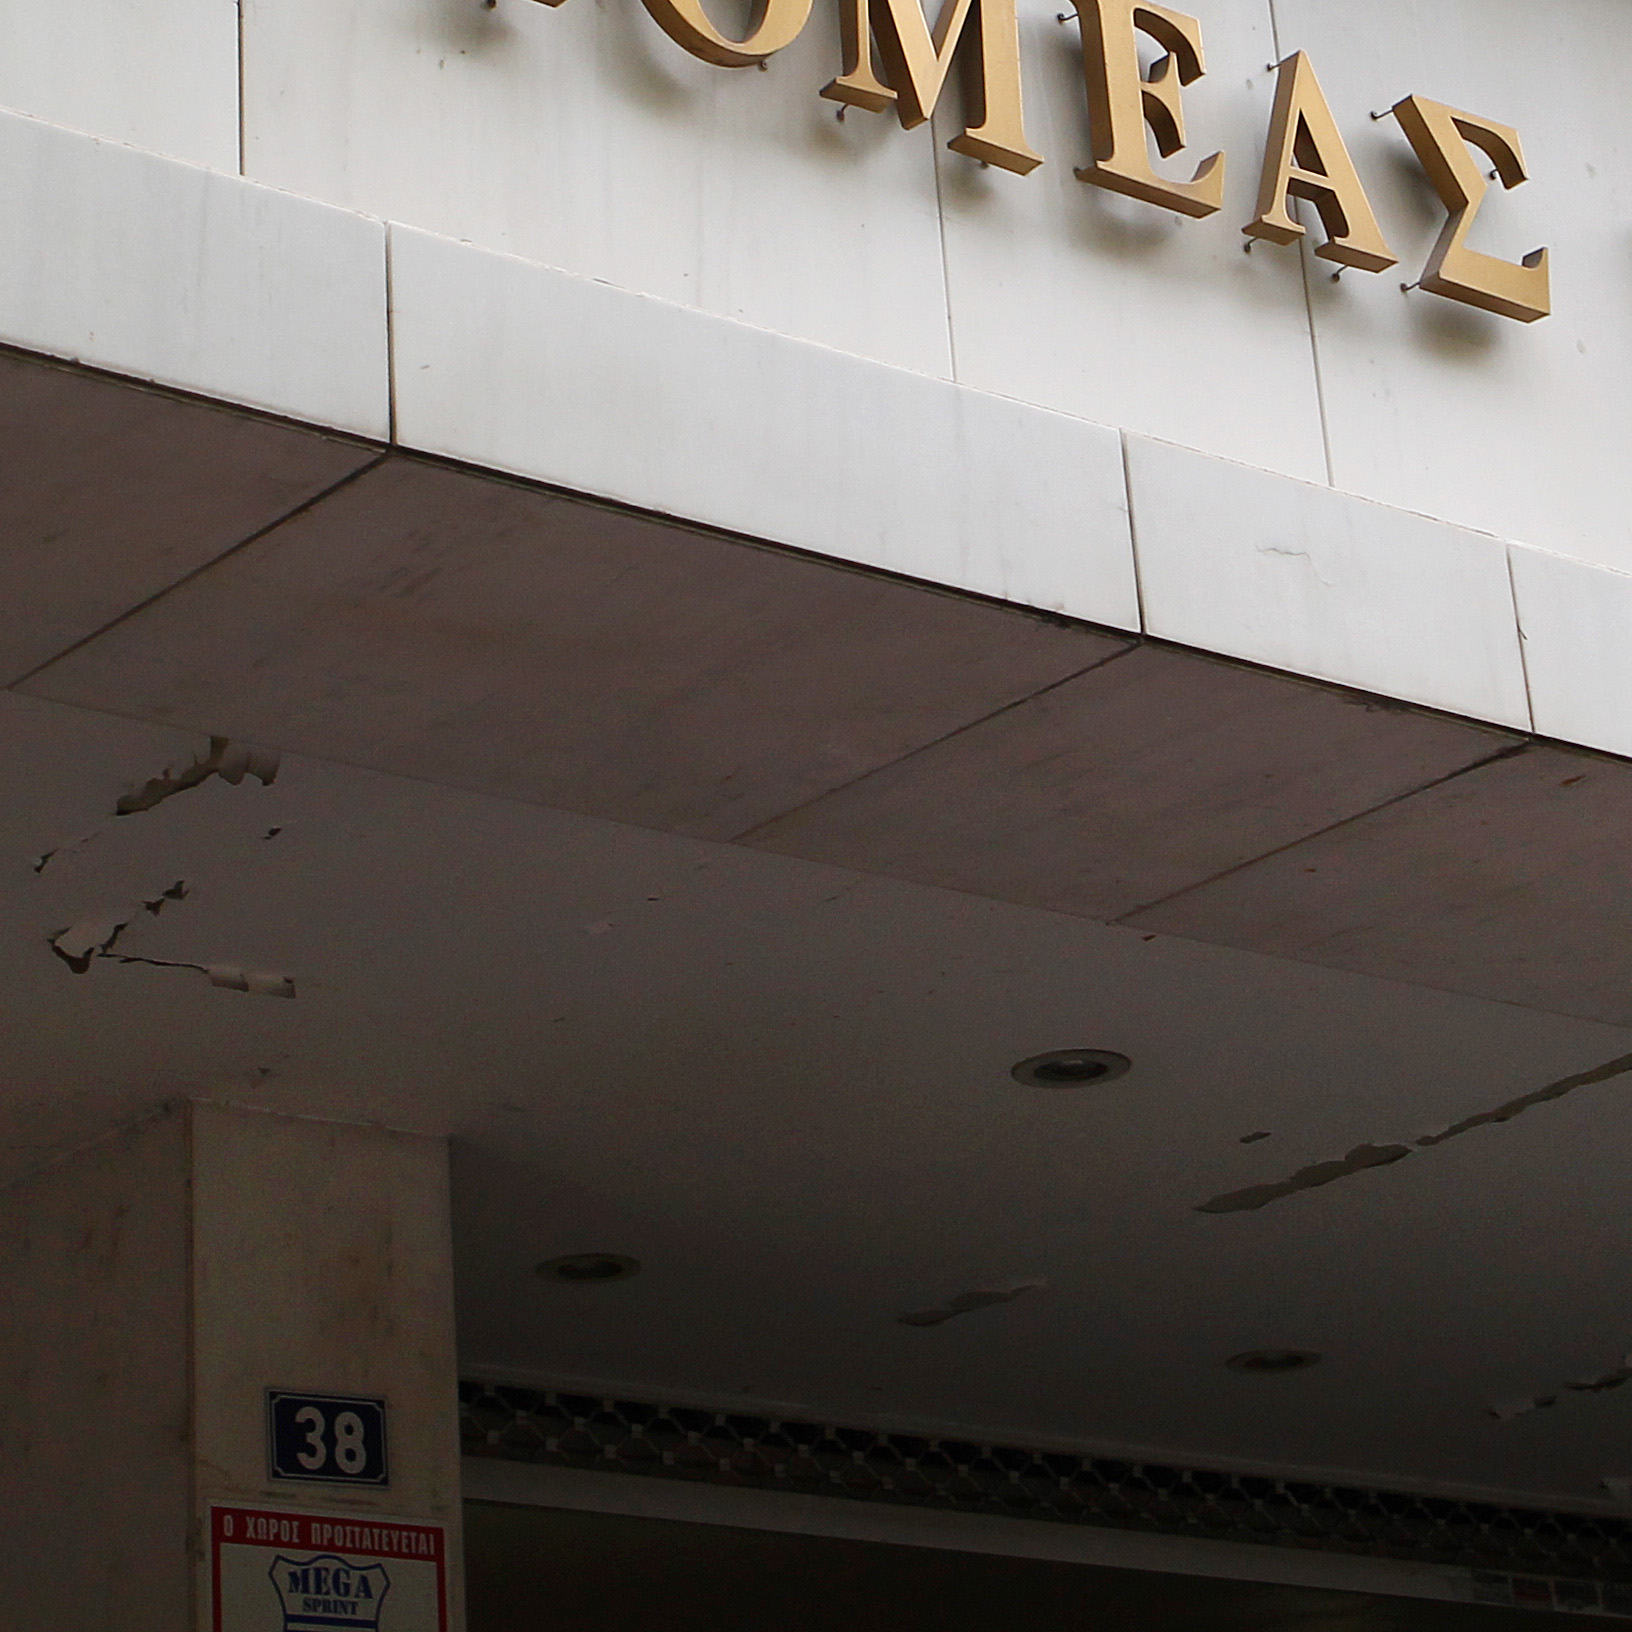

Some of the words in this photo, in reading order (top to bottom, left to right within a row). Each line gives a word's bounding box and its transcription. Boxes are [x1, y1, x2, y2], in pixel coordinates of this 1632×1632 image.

[294, 1406, 368, 1475] 38
[222, 1514, 235, 1538] Ο
[245, 1516, 301, 1544] ΧΩΡΟΣ
[311, 1522, 436, 1556] ΠΡΟΣΤΑΤΕΥΕΤΑΙ
[287, 1566, 374, 1600] MEGA
[302, 1597, 359, 1616] SPRINT
